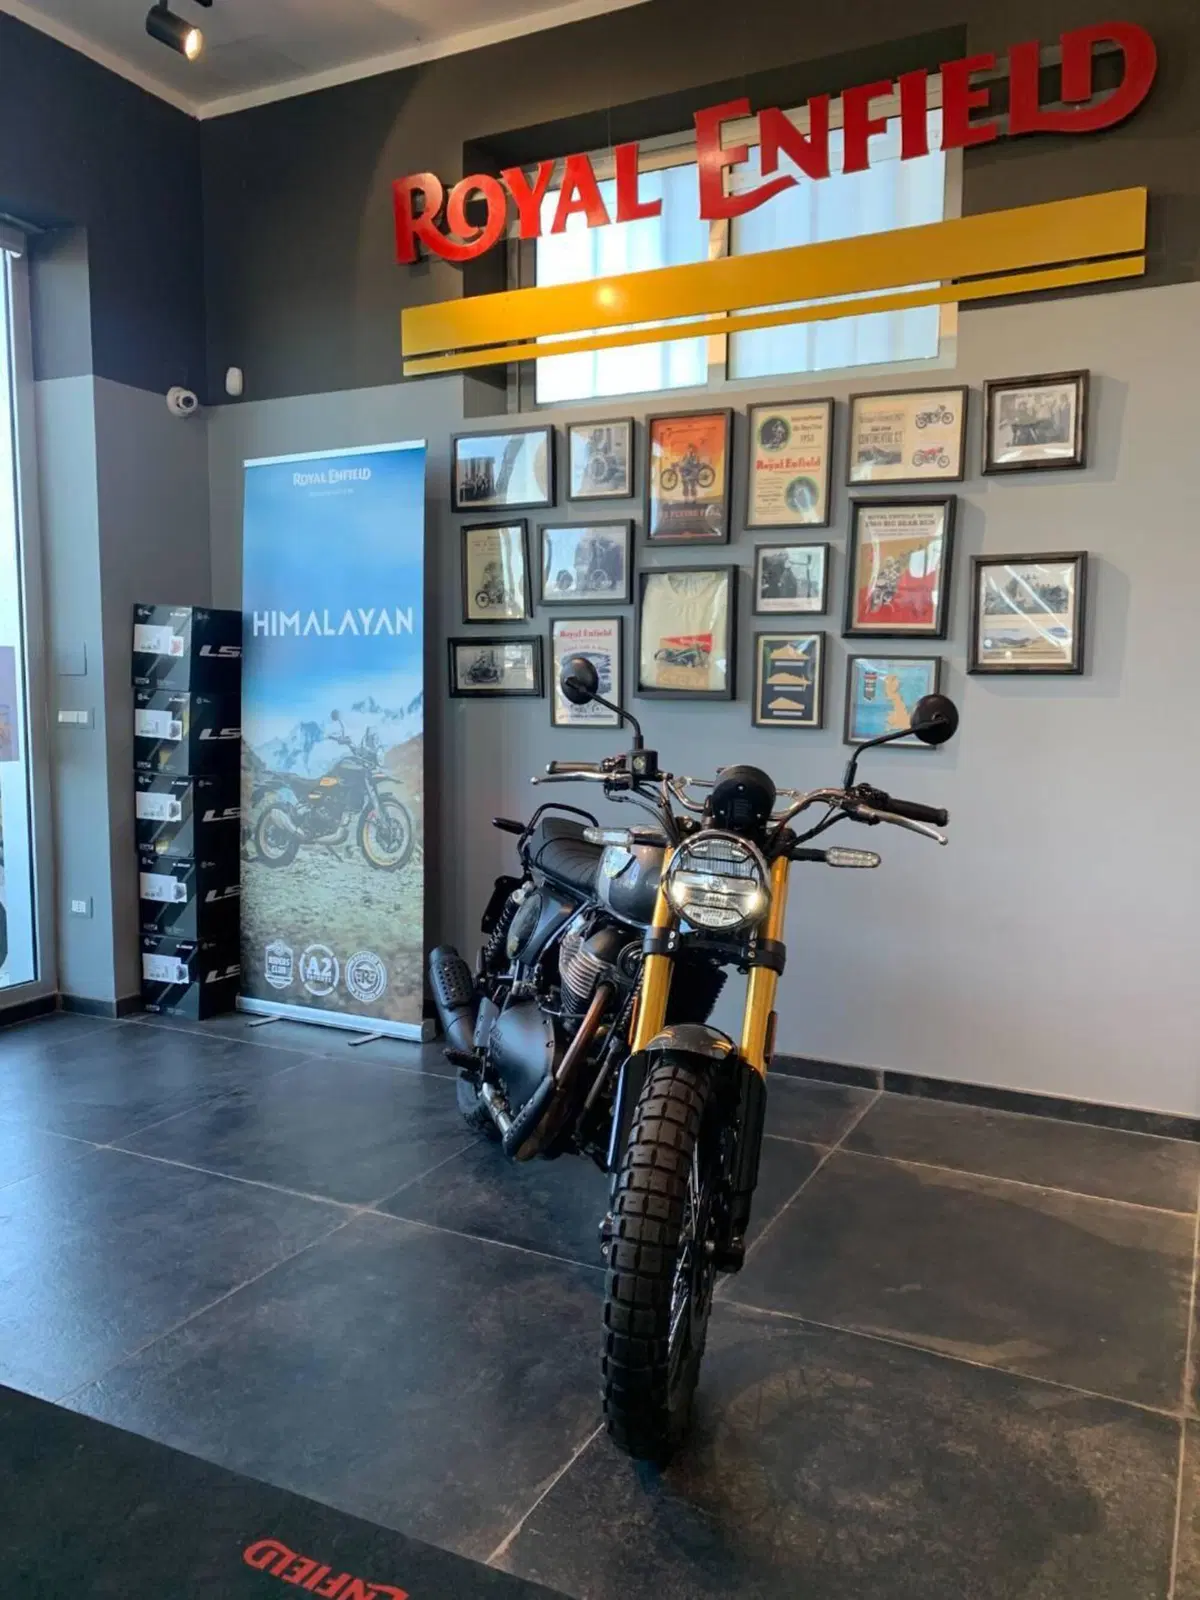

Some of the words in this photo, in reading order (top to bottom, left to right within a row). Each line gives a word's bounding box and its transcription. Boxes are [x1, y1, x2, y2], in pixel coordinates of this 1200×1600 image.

[392, 140, 662, 264] ROYAL
[693, 21, 1157, 220] ENFIELD
[292, 472, 327, 487] ROYAL
[328, 467, 371, 484] ENFIELD
[253, 606, 413, 637] HIMALAYAN
[199, 644, 242, 658] LS
[306, 956, 332, 976] A2
